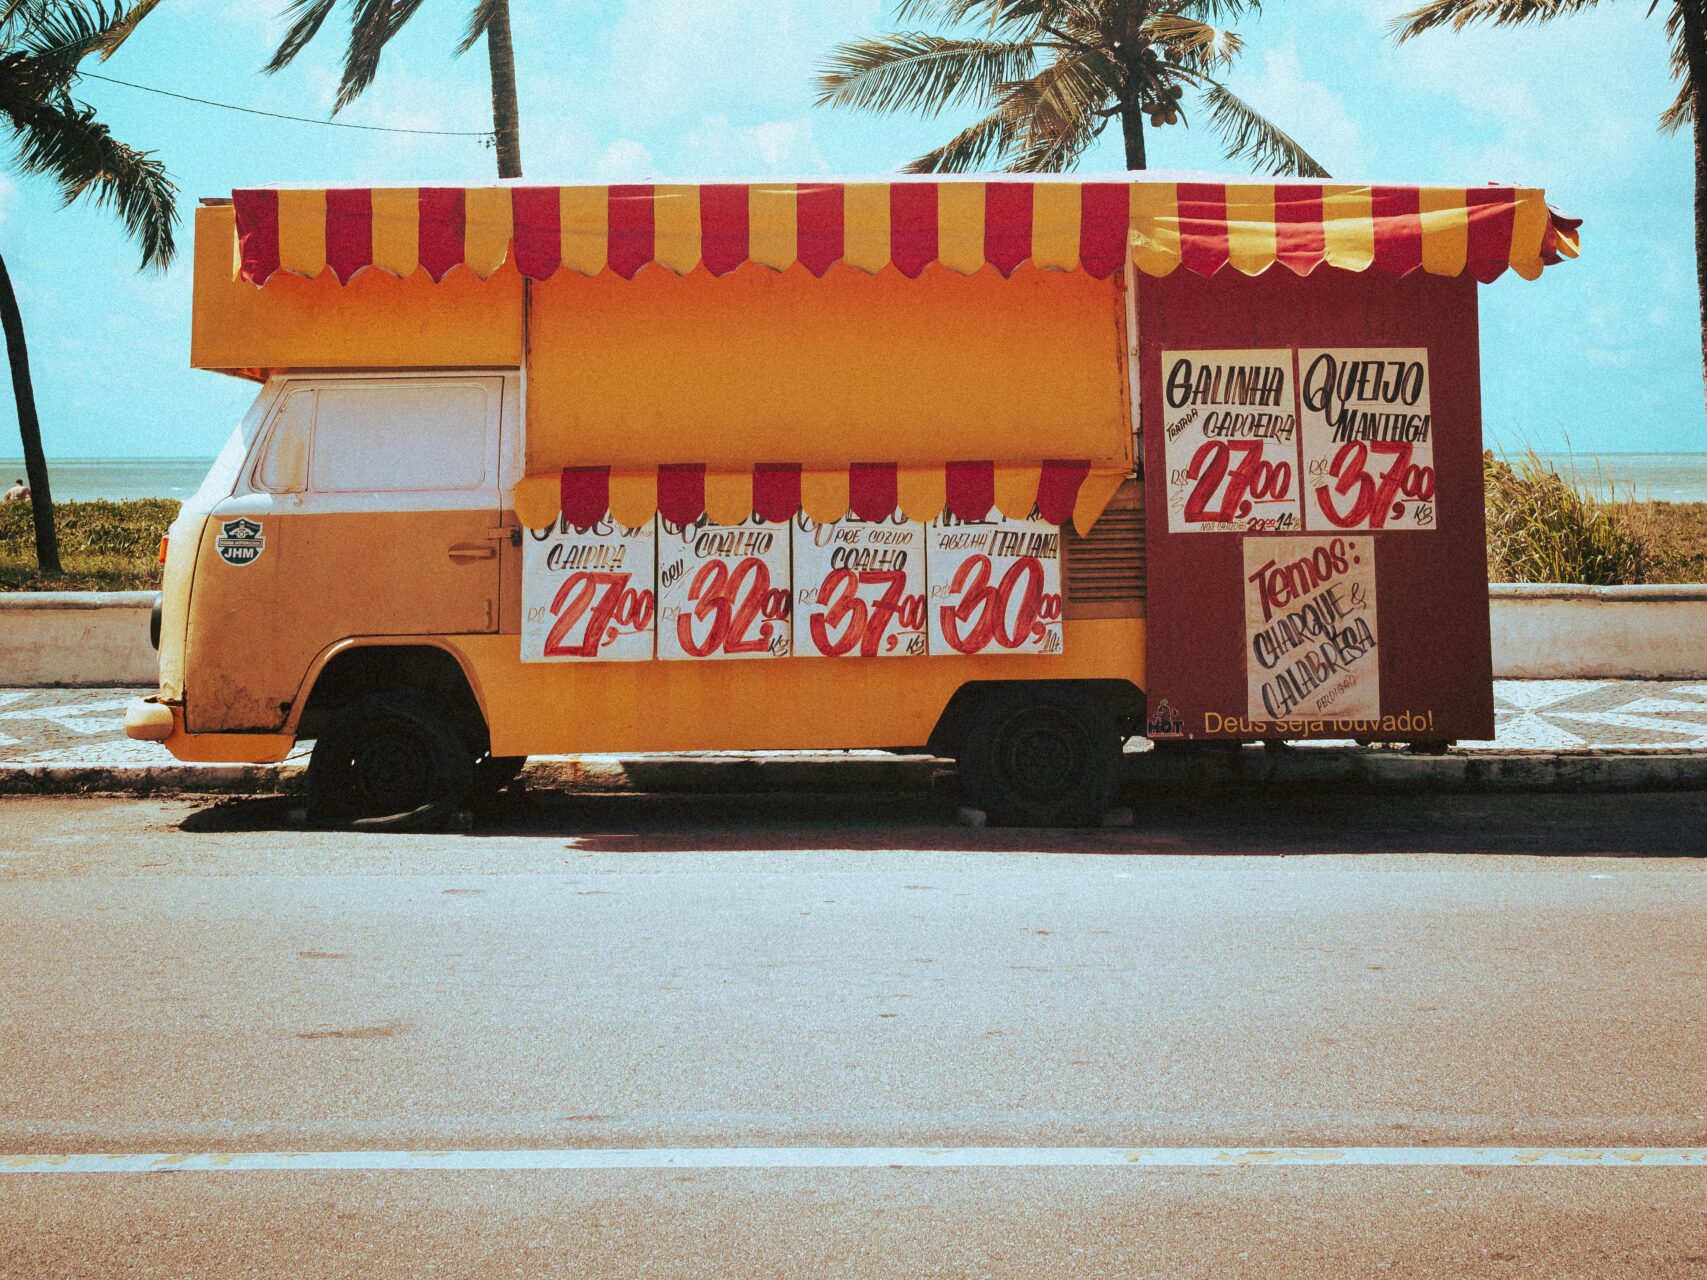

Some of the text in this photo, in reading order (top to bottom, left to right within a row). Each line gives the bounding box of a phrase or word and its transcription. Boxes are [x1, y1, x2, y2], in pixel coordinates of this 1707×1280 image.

[1166, 358, 1285, 408] GALINHA
[1302, 353, 1424, 426] QUEIJO
[1202, 411, 1295, 443] CAPOEIRA
[1332, 409, 1431, 443] MANTEIGA
[695, 531, 773, 558] COALHO
[868, 529, 913, 545] COZIDO
[987, 530, 1059, 558] ITALIANA
[224, 548, 254, 558] JHM
[547, 543, 626, 571] CAIPIRA
[831, 547, 908, 571] COALHO
[1248, 538, 1360, 623] Temos:
[1253, 582, 1367, 669] CHARQUE &
[1261, 617, 1377, 719] CALABRESA
[1147, 720, 1184, 733] HOT
[1204, 711, 1267, 733] Deus
